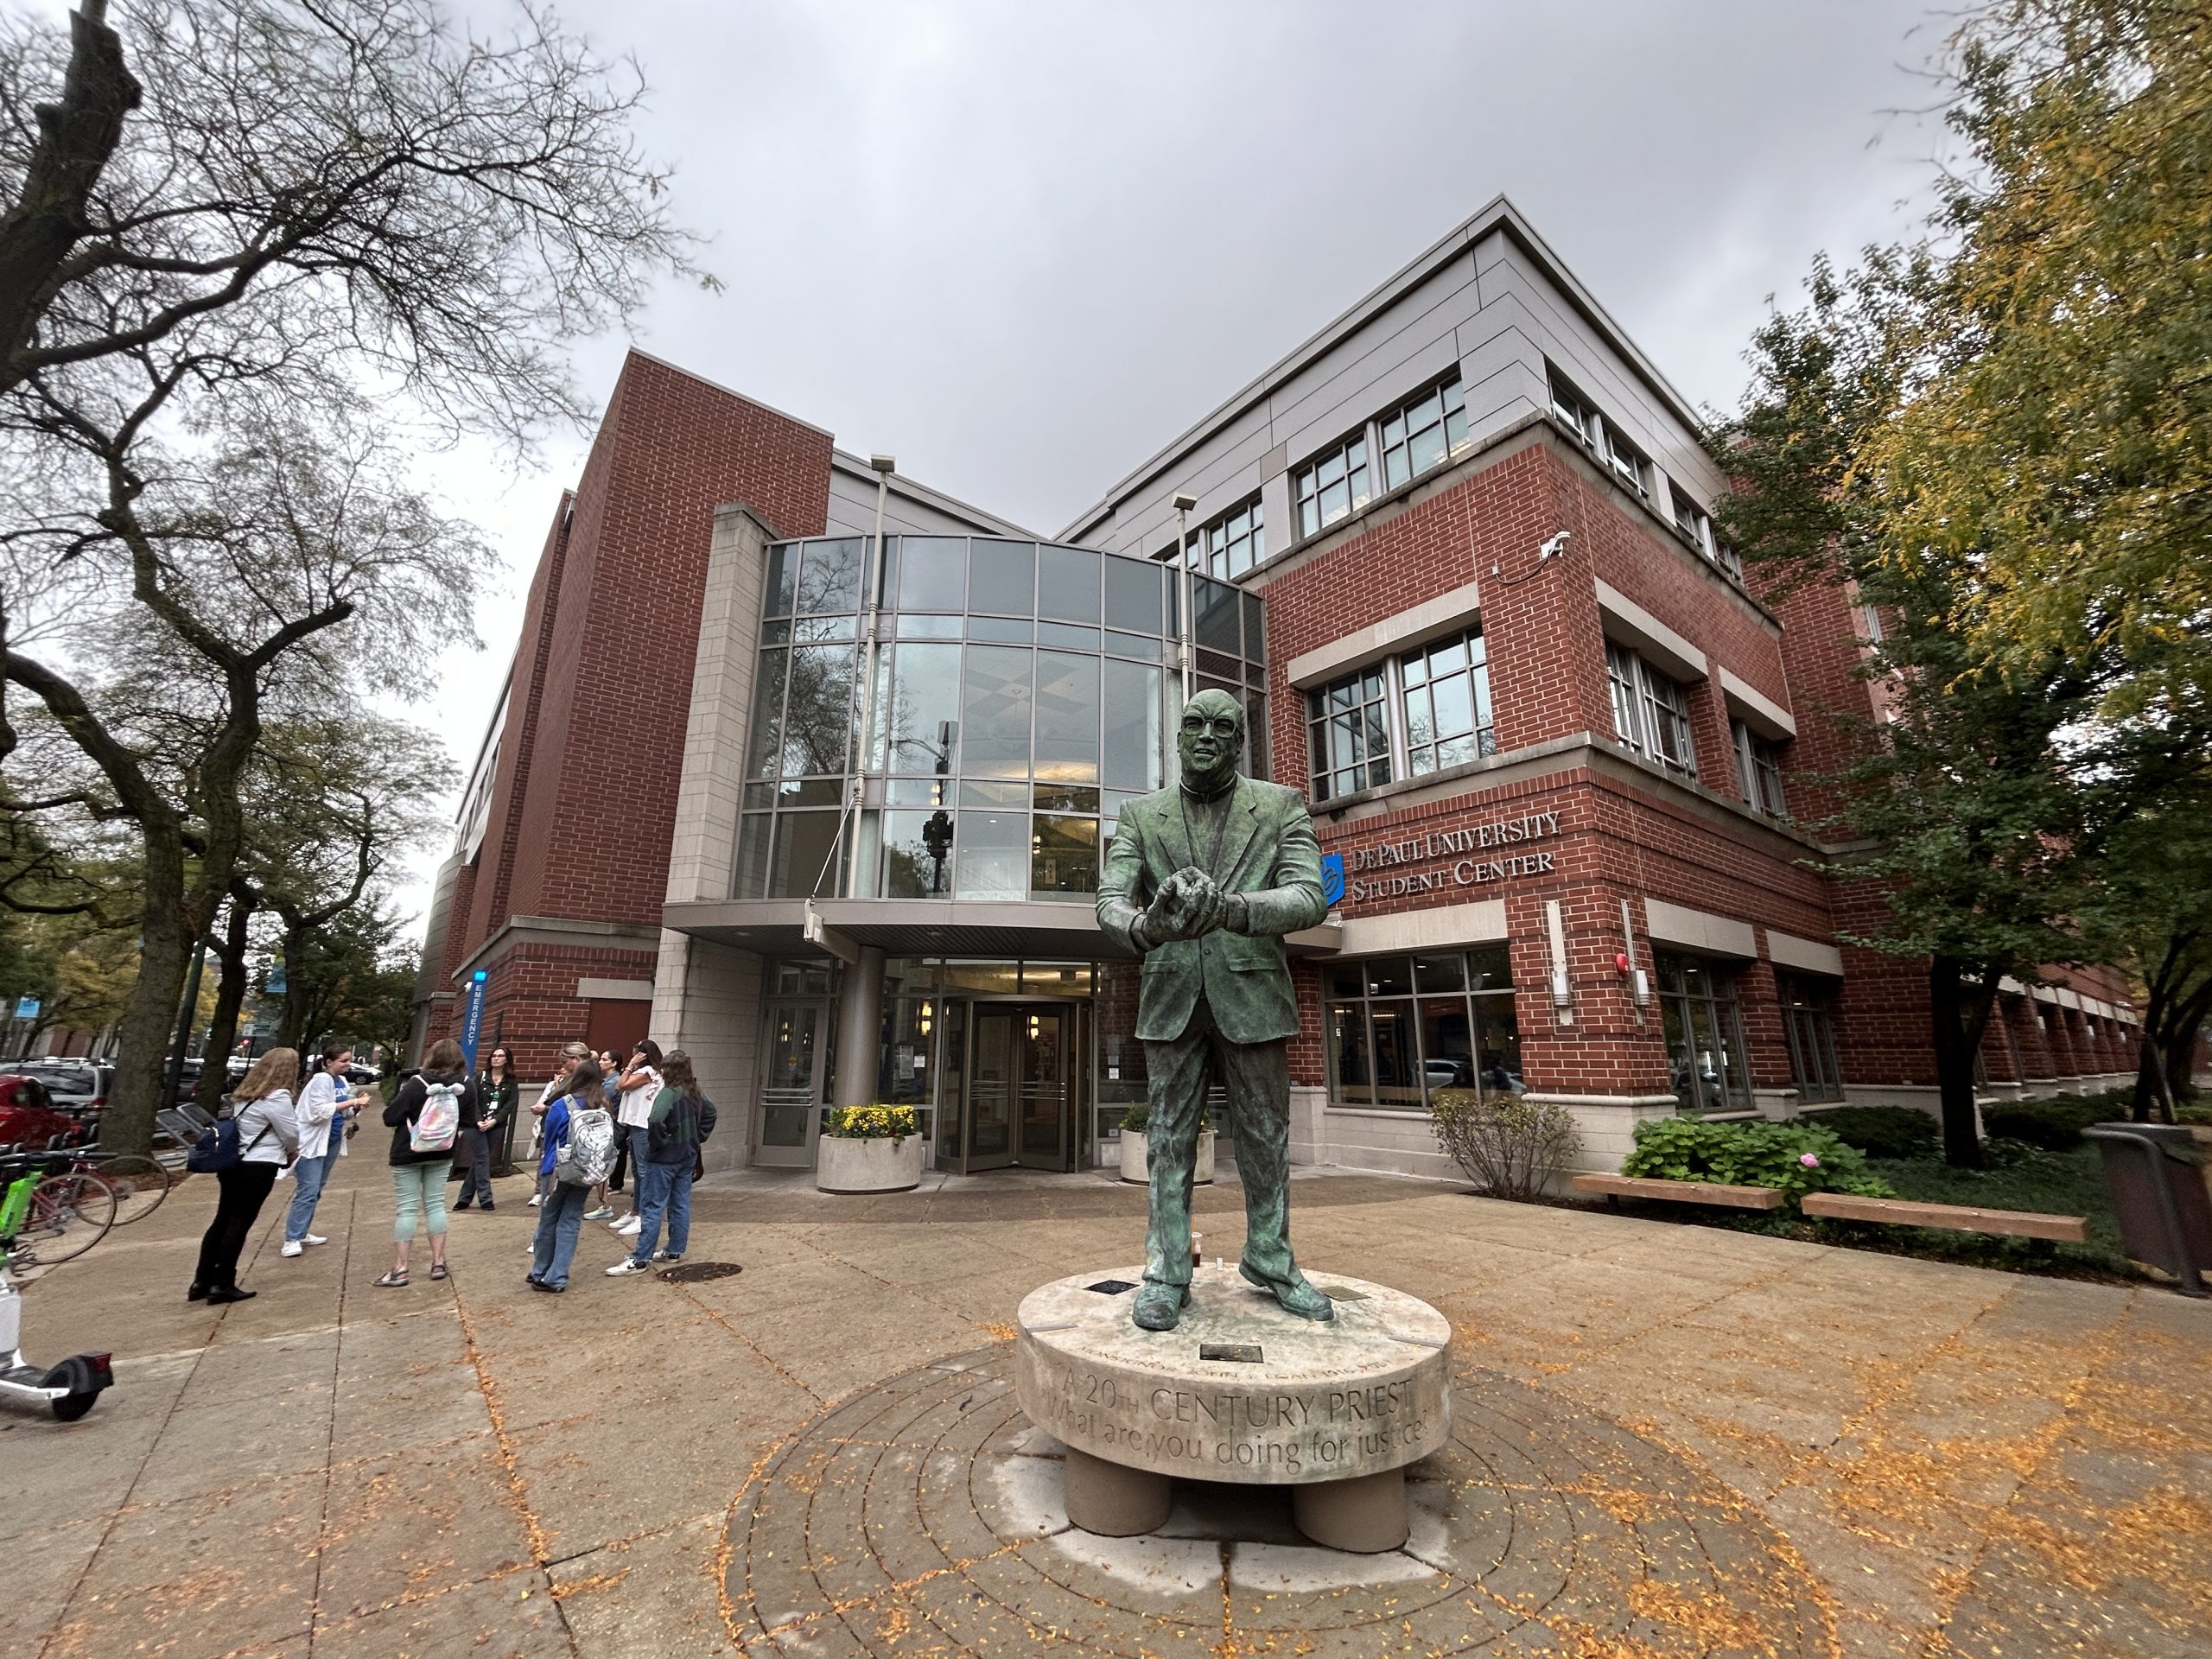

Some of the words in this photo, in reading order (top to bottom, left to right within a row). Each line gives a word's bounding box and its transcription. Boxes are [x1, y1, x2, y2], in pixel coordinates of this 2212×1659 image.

[1427, 810, 1562, 857] UNIVERSITY
[1351, 870, 1447, 902] STUDENT
[1453, 853, 1555, 886] CENTER
[467, 984, 483, 1046] EMERGENCY
[1062, 1367, 1077, 1395] A
[1150, 1388, 1315, 1428] CENTURY
[1329, 1378, 1412, 1424] PRIEST
[1043, 1391, 1096, 1440] What
[1148, 1432, 1203, 1464] you
[1215, 1428, 1301, 1475] doing
[1312, 1431, 1348, 1463] for
